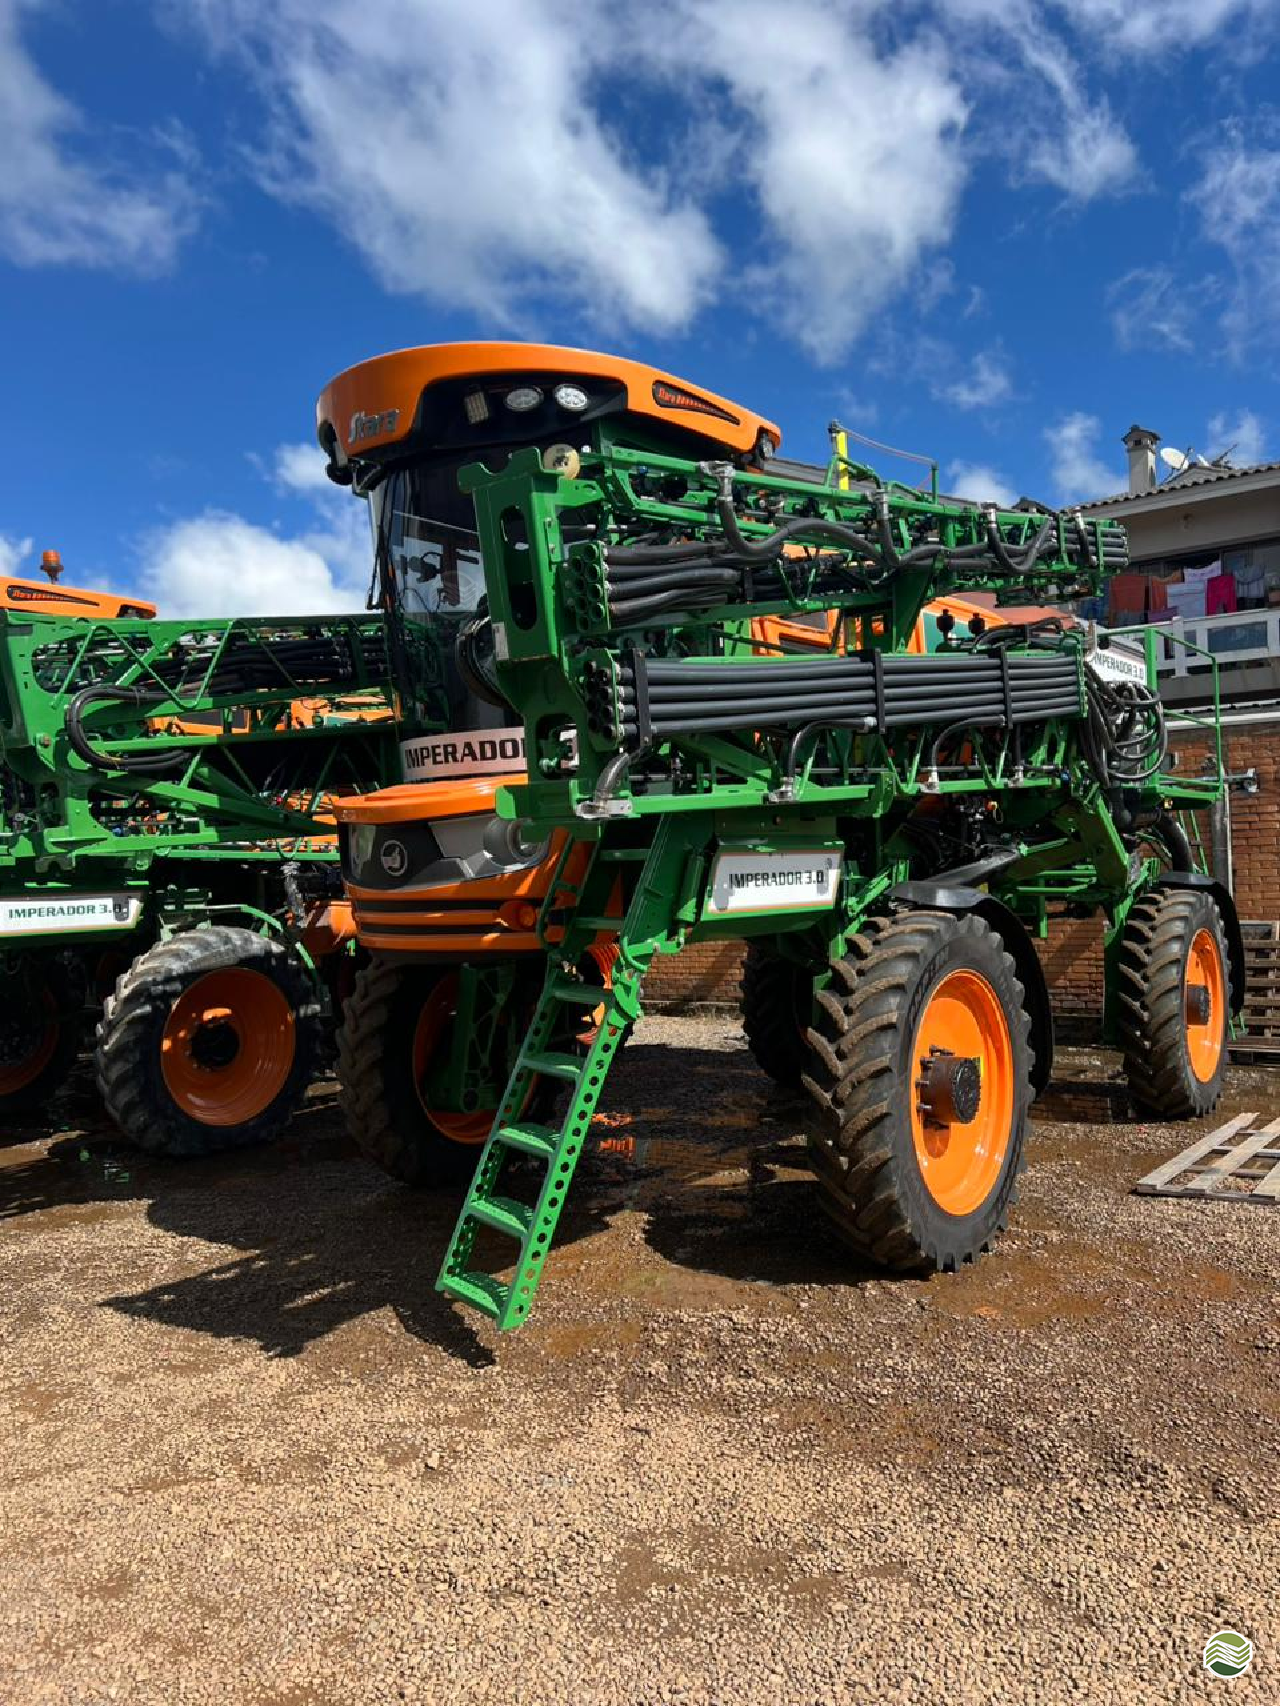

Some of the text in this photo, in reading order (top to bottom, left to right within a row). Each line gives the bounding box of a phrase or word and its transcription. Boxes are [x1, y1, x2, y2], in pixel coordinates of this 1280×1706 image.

[348, 409, 400, 443] Stara
[729, 869, 824, 889] IMPERADOR 3.0
[9, 903, 122, 918] IMPERADOR 3.0
